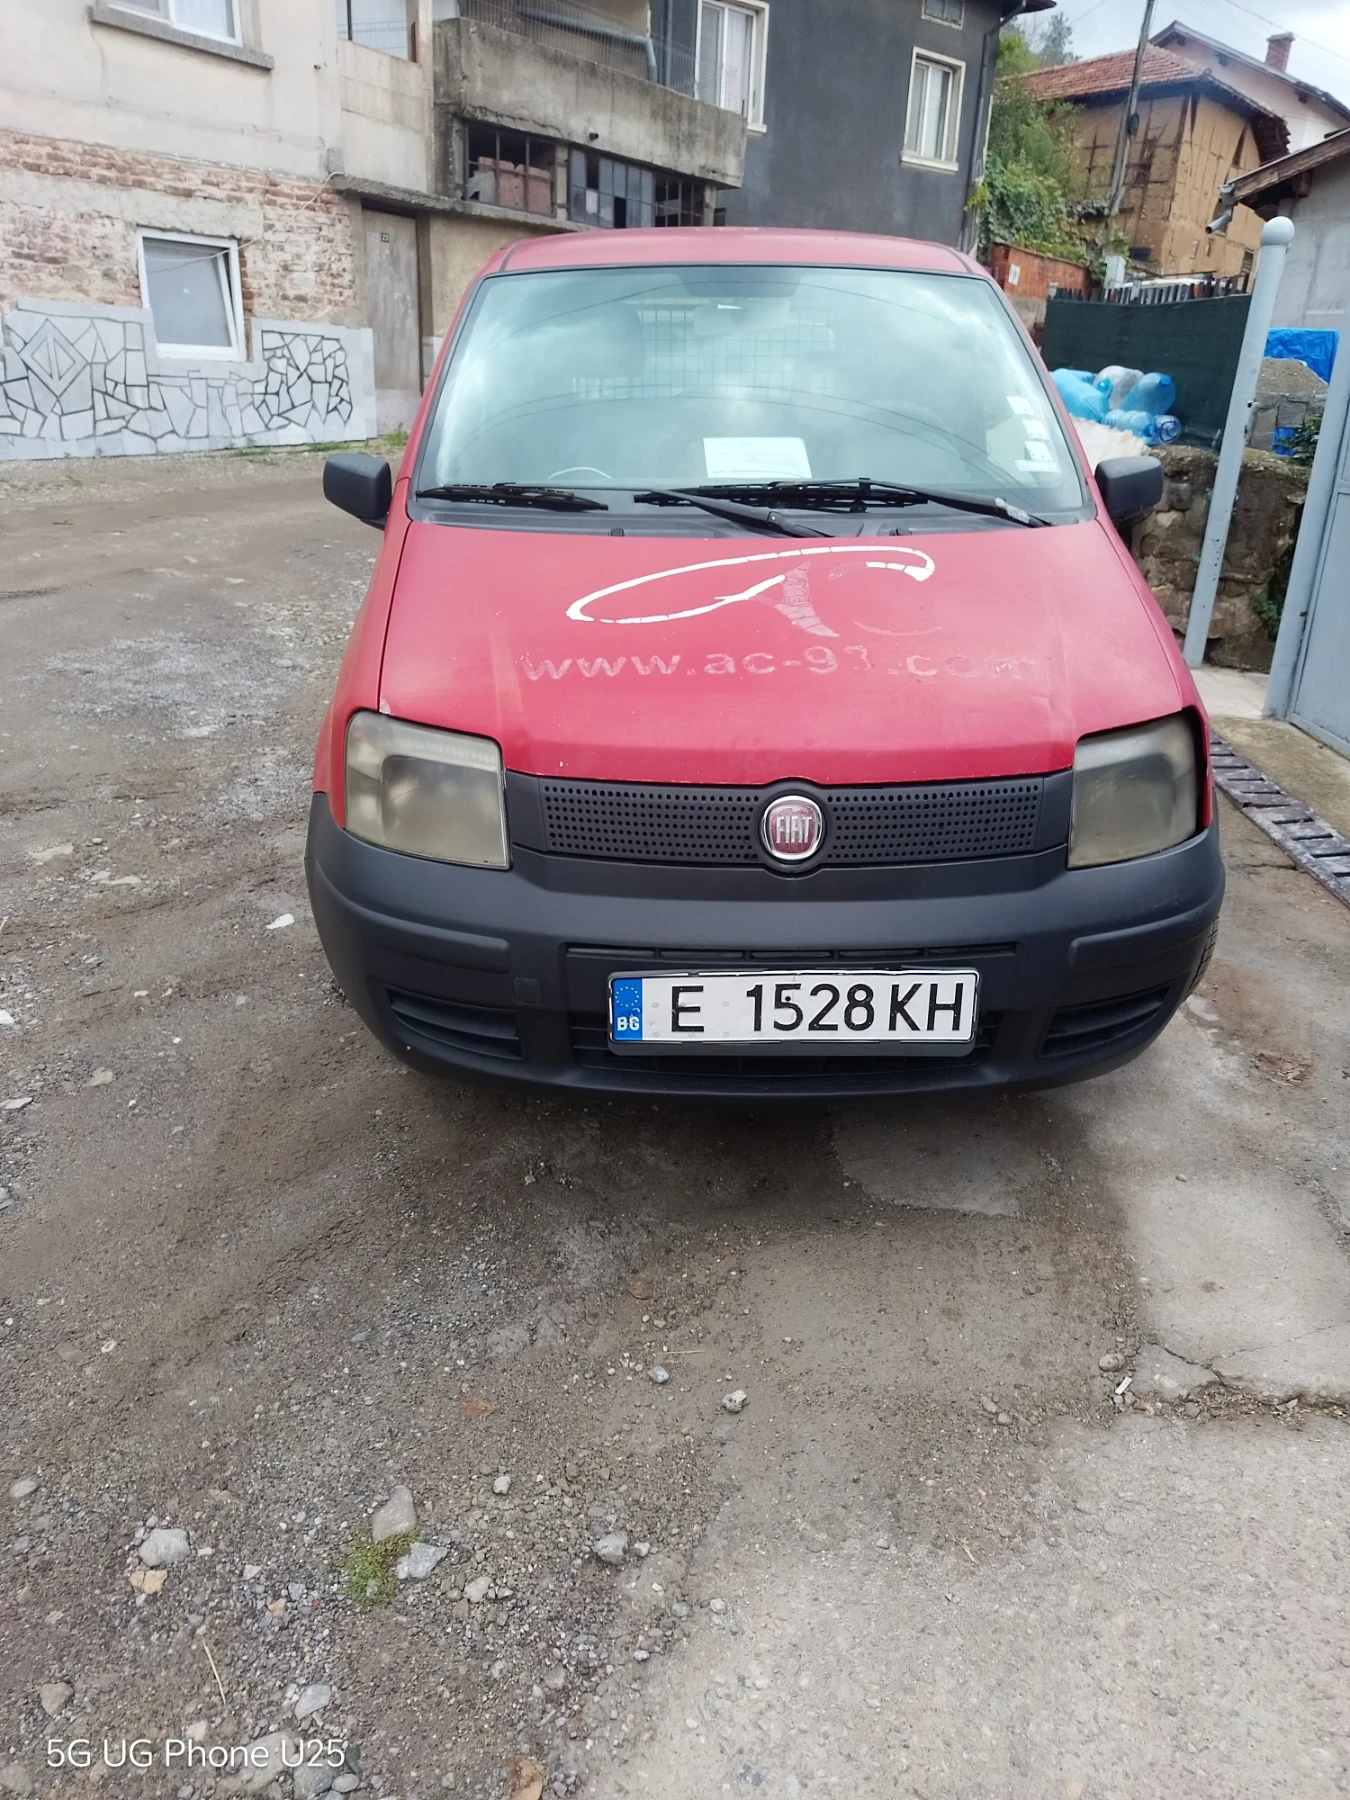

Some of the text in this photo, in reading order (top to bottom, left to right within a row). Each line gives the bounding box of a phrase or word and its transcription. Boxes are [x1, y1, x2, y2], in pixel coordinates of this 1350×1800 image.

[776, 815, 813, 844] FIAT
[671, 985, 704, 1032] E
[617, 1016, 640, 1031] BG
